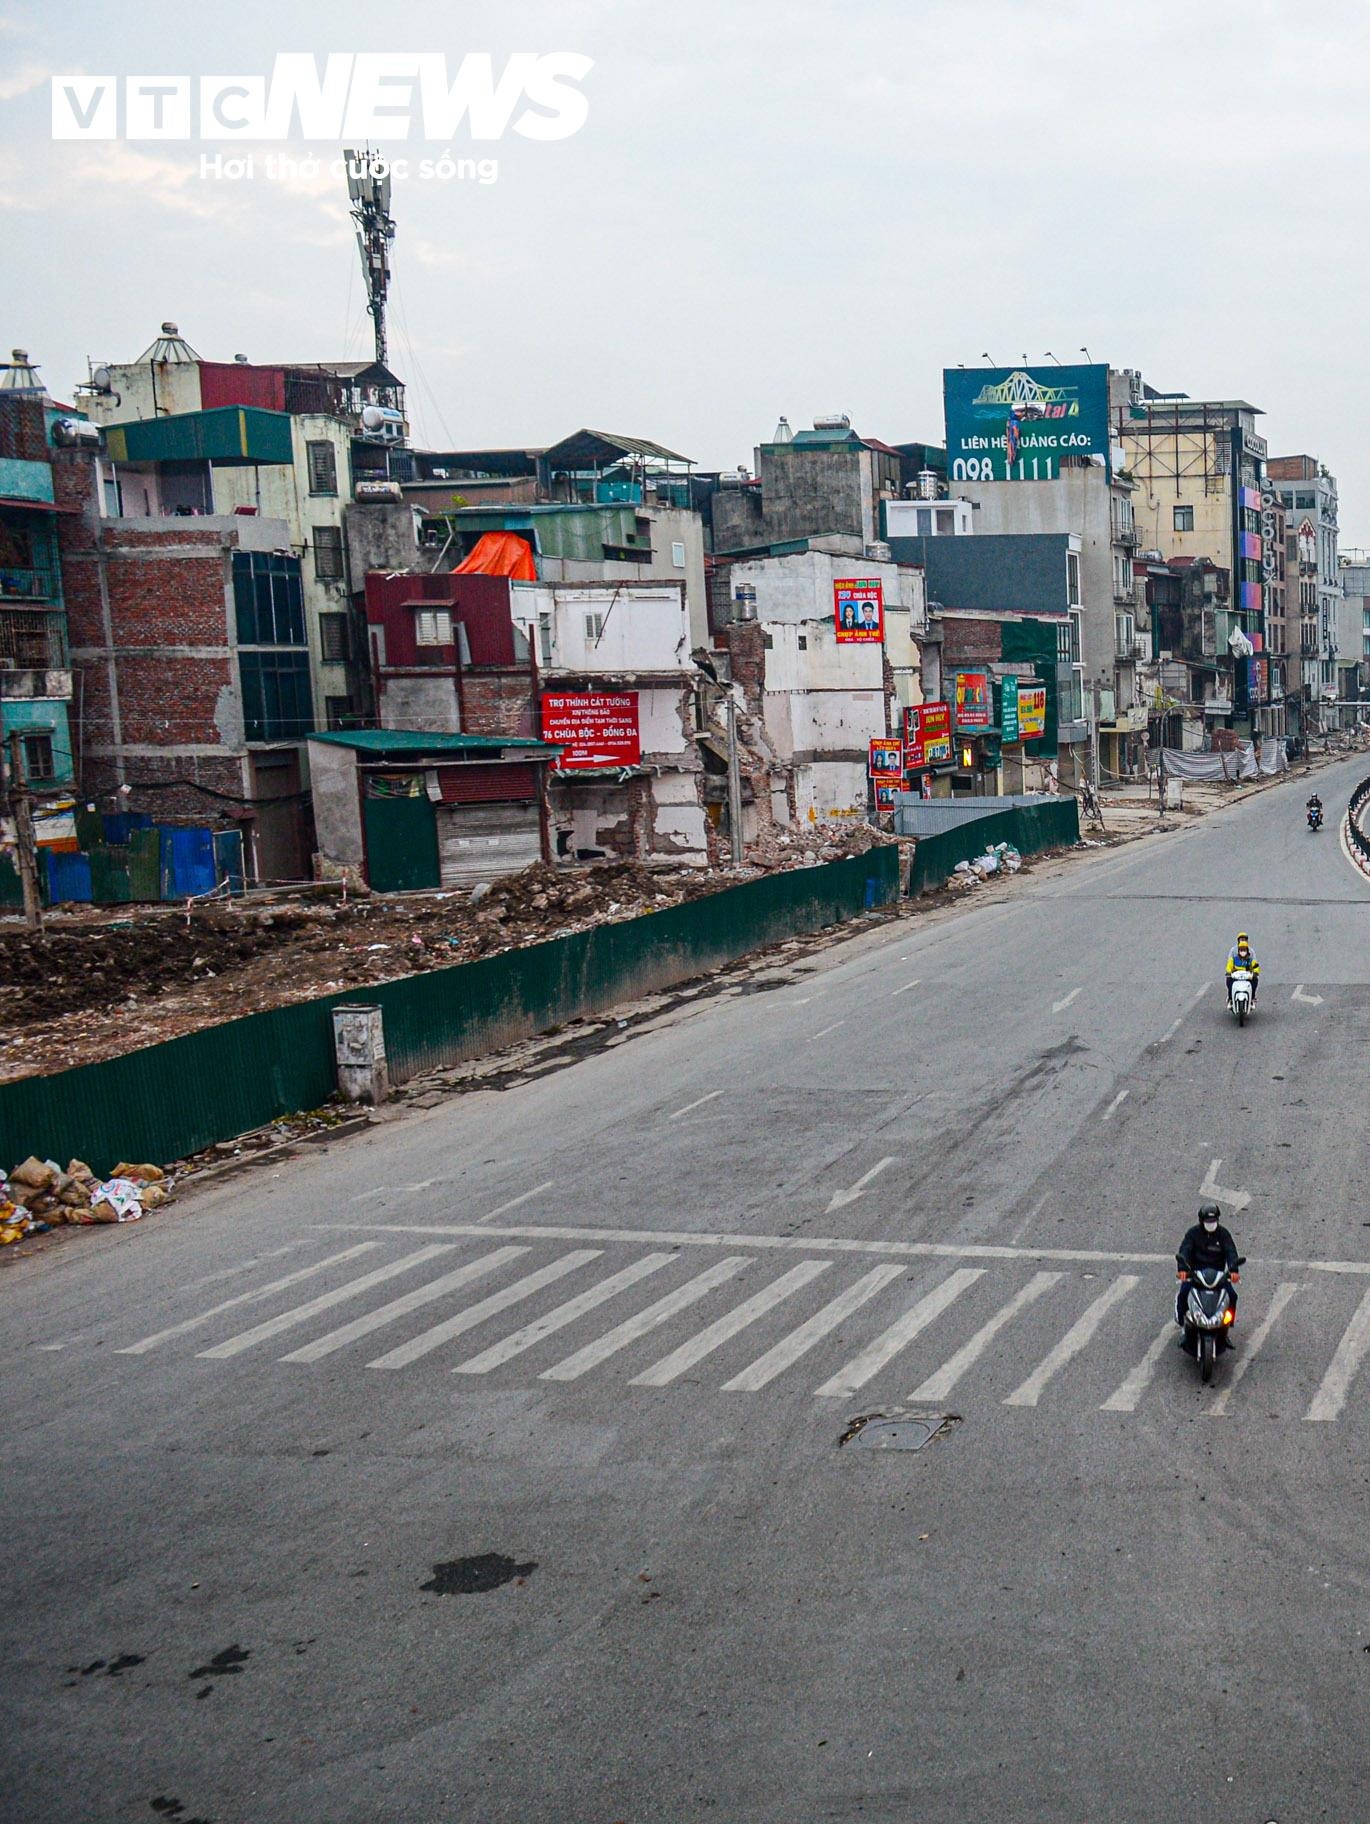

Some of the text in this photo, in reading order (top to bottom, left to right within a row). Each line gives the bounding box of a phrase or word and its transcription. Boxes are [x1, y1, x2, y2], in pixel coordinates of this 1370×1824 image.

[961, 435, 989, 450] LIÊN
[991, 434, 1009, 452] HỆ
[1060, 432, 1091, 447] CÁO:
[590, 697, 605, 707] CÁT
